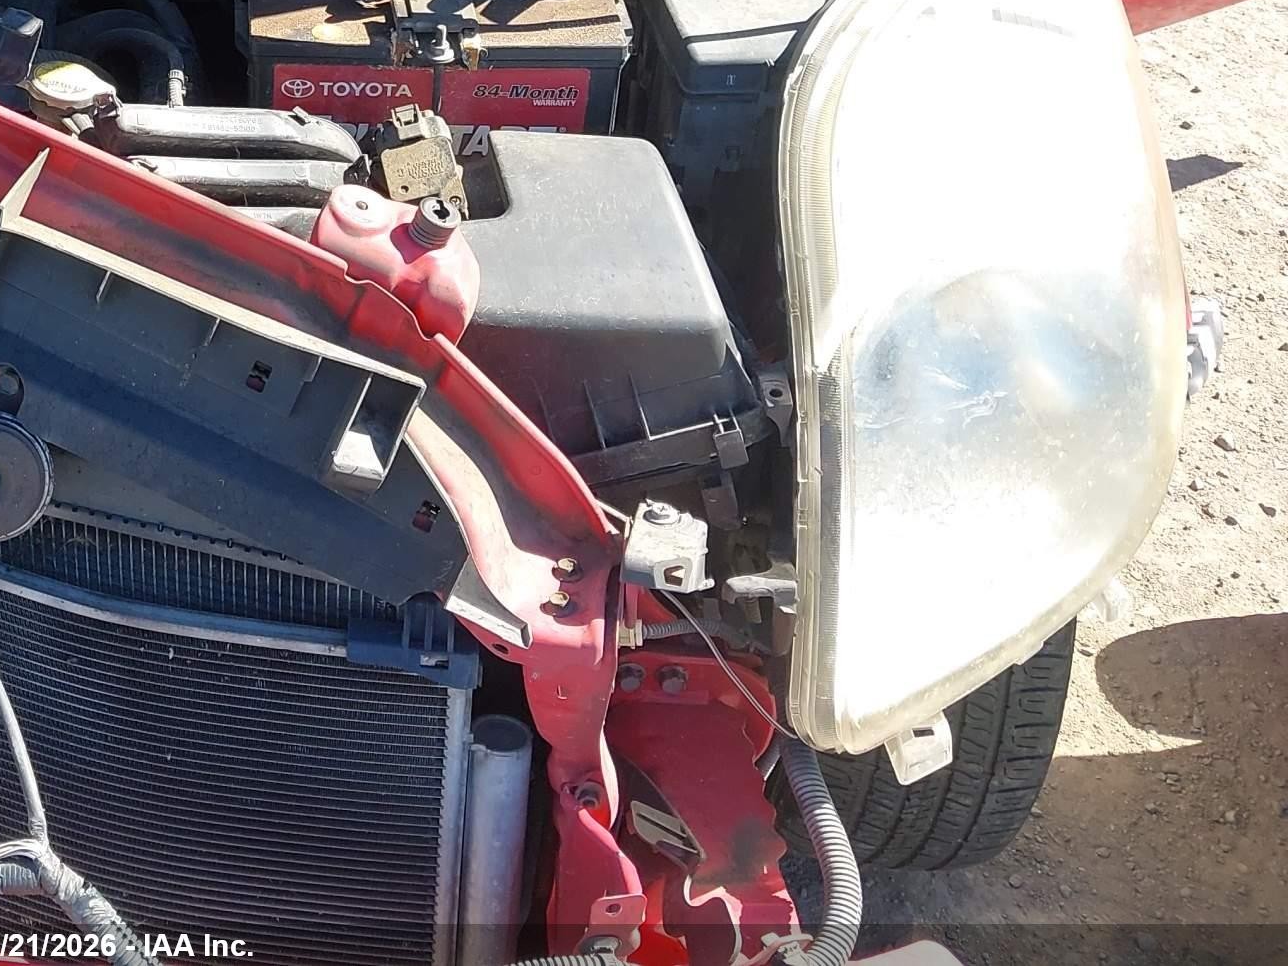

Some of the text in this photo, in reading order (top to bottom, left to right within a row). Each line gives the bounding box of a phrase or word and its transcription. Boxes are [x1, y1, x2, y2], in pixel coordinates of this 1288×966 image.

[319, 81, 413, 97] TOYOTA
[473, 84, 579, 100] 84-Month
[532, 99, 577, 107] WARRANTY
